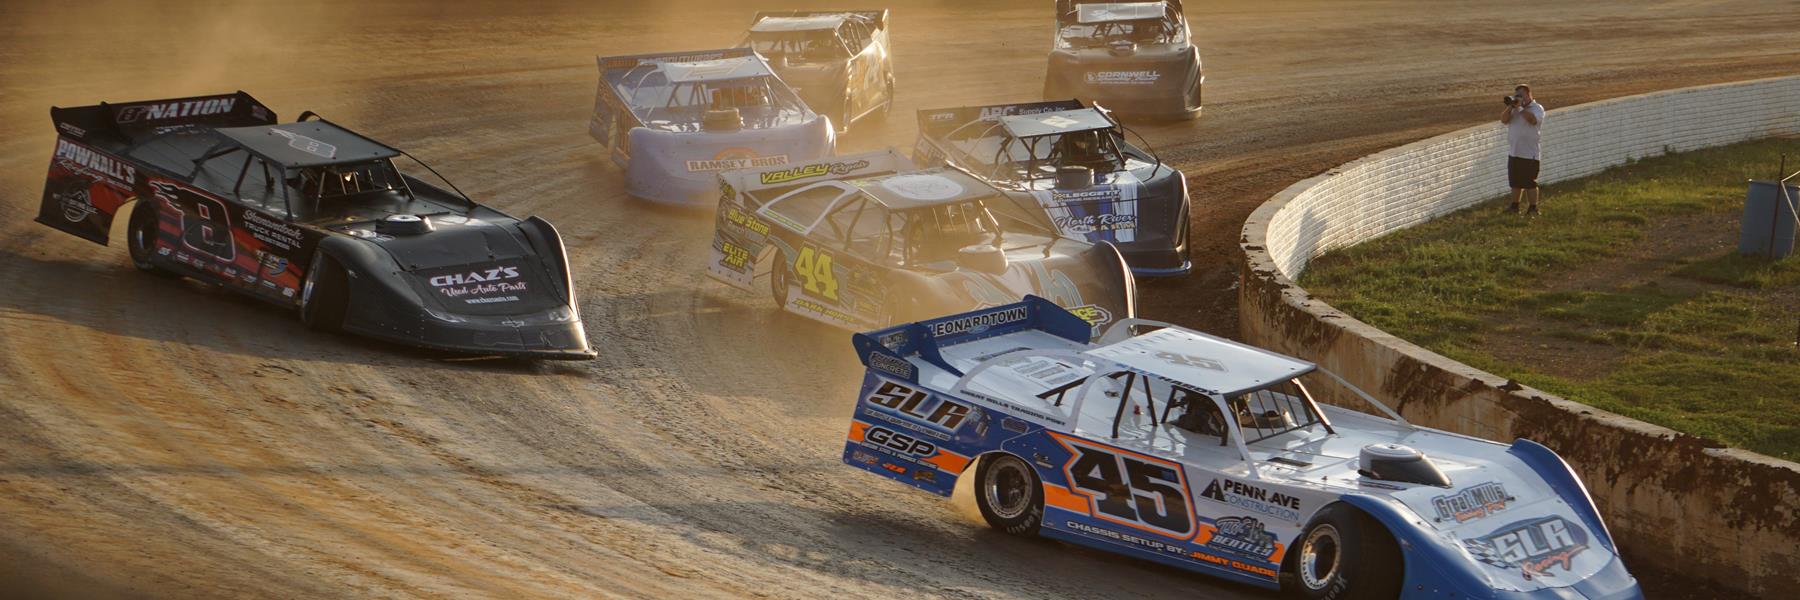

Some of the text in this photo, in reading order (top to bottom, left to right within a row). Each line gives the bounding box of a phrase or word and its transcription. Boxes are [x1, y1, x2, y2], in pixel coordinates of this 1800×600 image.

[146, 98, 236, 119] NATION
[56, 139, 136, 185] POWNALL'S
[690, 156, 786, 171] RAMSEY BROS
[761, 163, 828, 184] VALLEY
[1065, 189, 1121, 199] LEGGETT
[162, 184, 236, 262] 8
[244, 221, 270, 237] TRUCK
[271, 231, 302, 249] RENTAL
[728, 208, 747, 225] Blue
[745, 216, 769, 236] Stone
[1055, 215, 1097, 229] North
[1098, 213, 1136, 225] River
[430, 266, 519, 287] CHAZ'S
[795, 246, 838, 300] 44
[441, 281, 527, 297] Used Auto Parts
[868, 380, 971, 429] SLR
[959, 389, 1066, 426] GREAT MILLS TRADING POST
[866, 427, 935, 456] GSP
[1070, 444, 1191, 534] 45
[1223, 478, 1301, 511] PENN AVE
[1435, 484, 1505, 519] Great Mills
[1224, 493, 1300, 522] CONSTRUCTION
[1066, 521, 1120, 541] CHASSIS
[1122, 534, 1165, 550] SETUP
[1166, 545, 1187, 557] BY:
[1189, 551, 1229, 567] JIMMY
[1492, 519, 1575, 564] SLR
